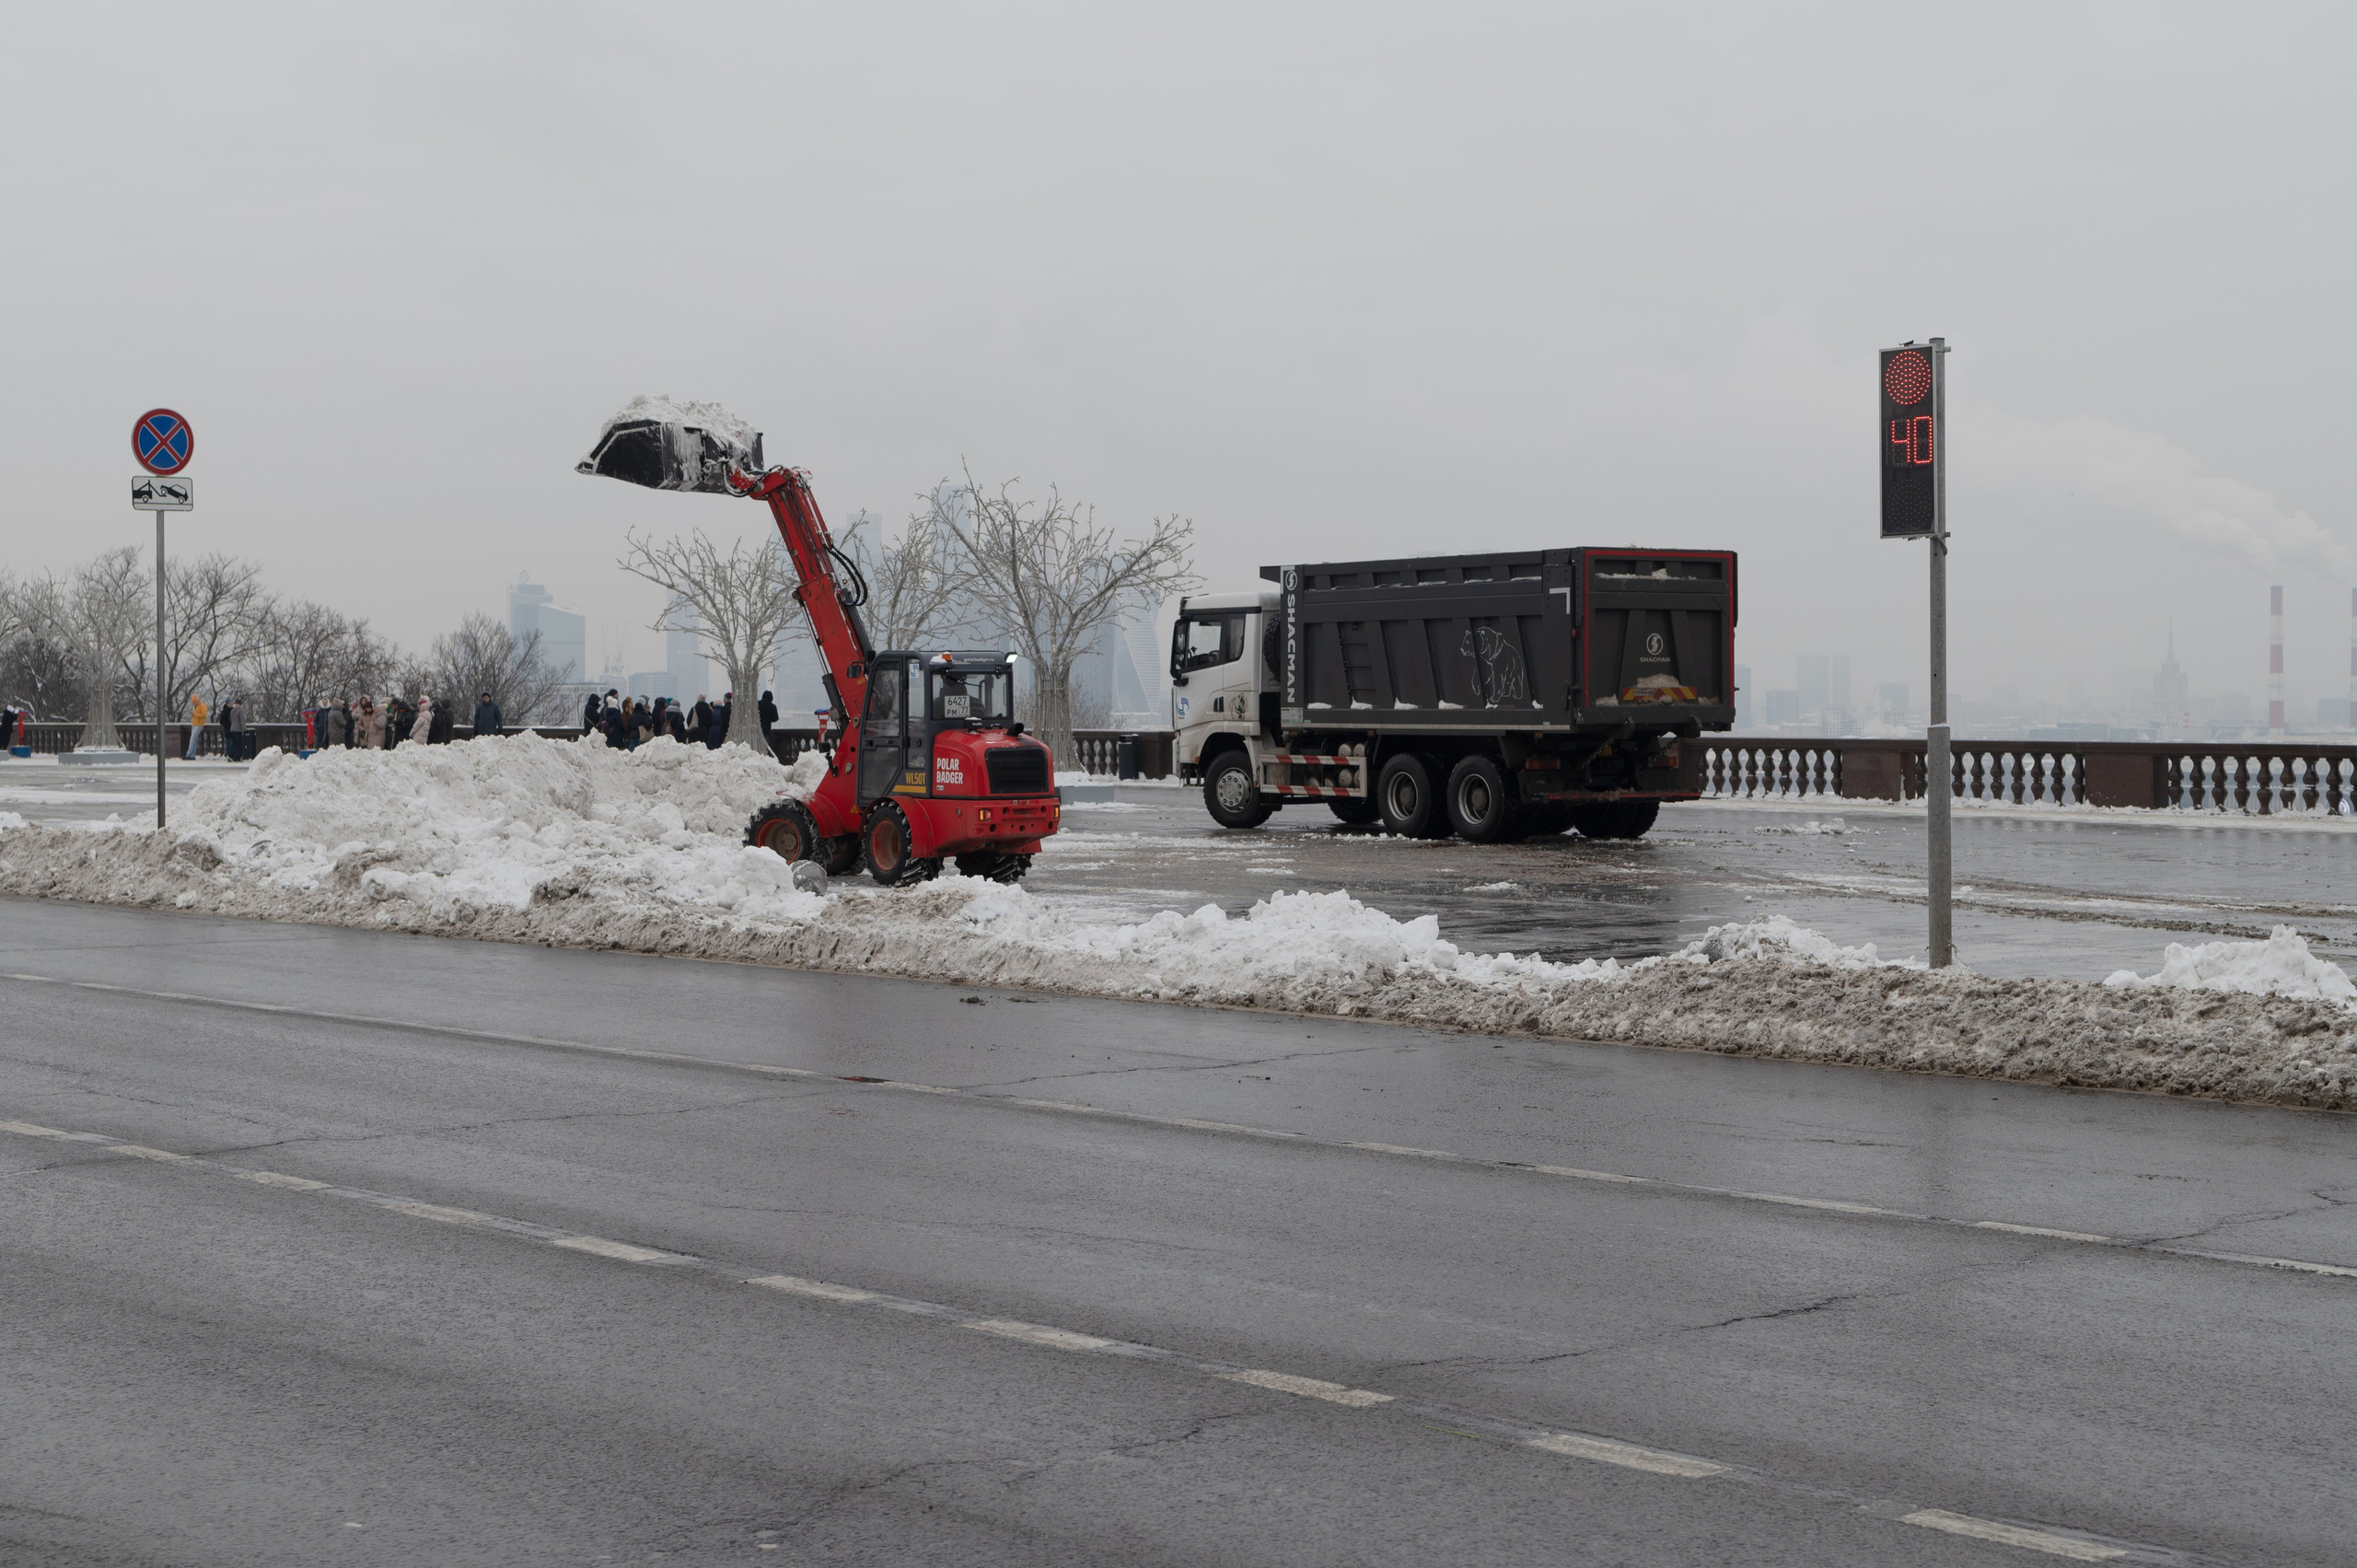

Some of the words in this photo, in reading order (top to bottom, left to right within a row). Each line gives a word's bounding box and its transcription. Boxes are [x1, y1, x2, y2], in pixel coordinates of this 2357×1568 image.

[1891, 415, 1933, 464] 40
[1287, 593, 1295, 703] SHACMAN
[947, 696, 967, 706] 6427
[936, 758, 959, 771] POLAR
[905, 772, 926, 784] WL50T
[936, 772, 964, 784] BADGER
